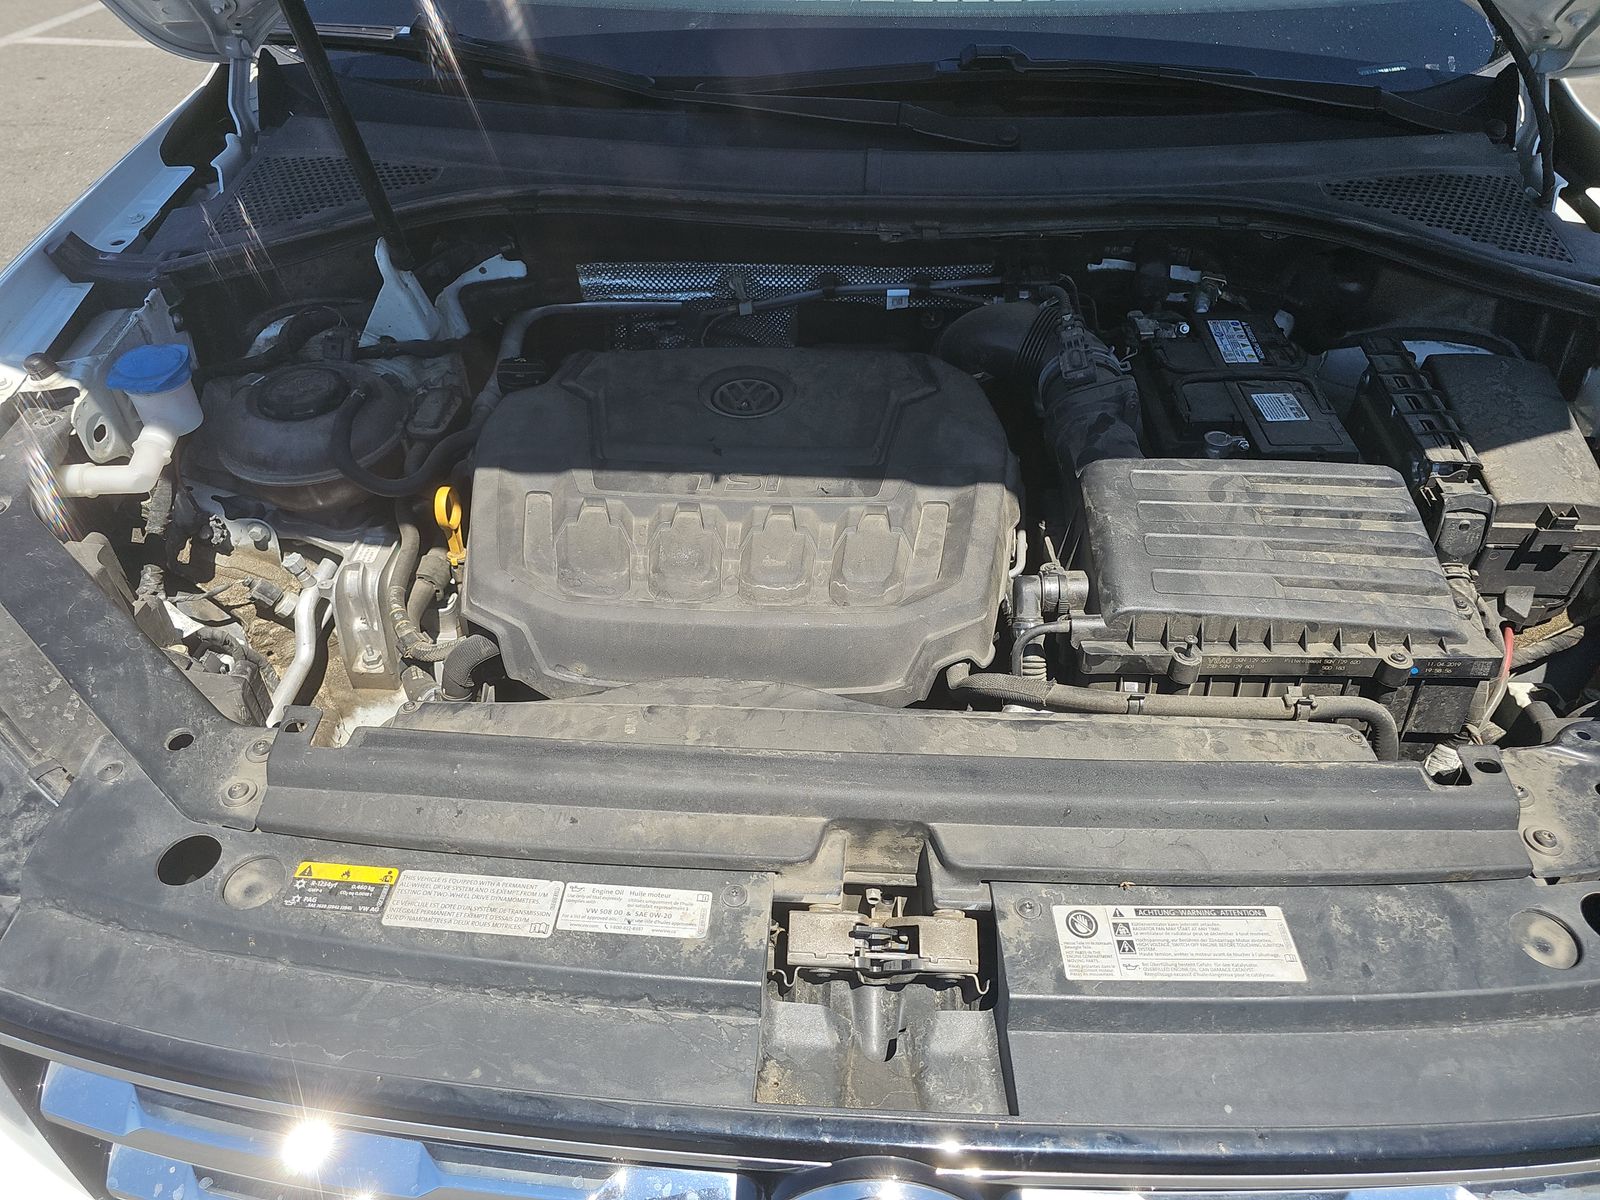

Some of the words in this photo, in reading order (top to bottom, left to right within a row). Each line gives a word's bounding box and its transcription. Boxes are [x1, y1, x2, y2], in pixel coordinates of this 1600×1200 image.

[448, 878, 478, 886] EQUIPPED
[501, 882, 538, 890] PERMANENT
[496, 888, 520, 896] EXEMPT
[592, 888, 614, 896] Engine
[303, 896, 318, 904] PAG
[420, 909, 455, 917] PERMANENT
[507, 908, 552, 917] TRANSMISSION
